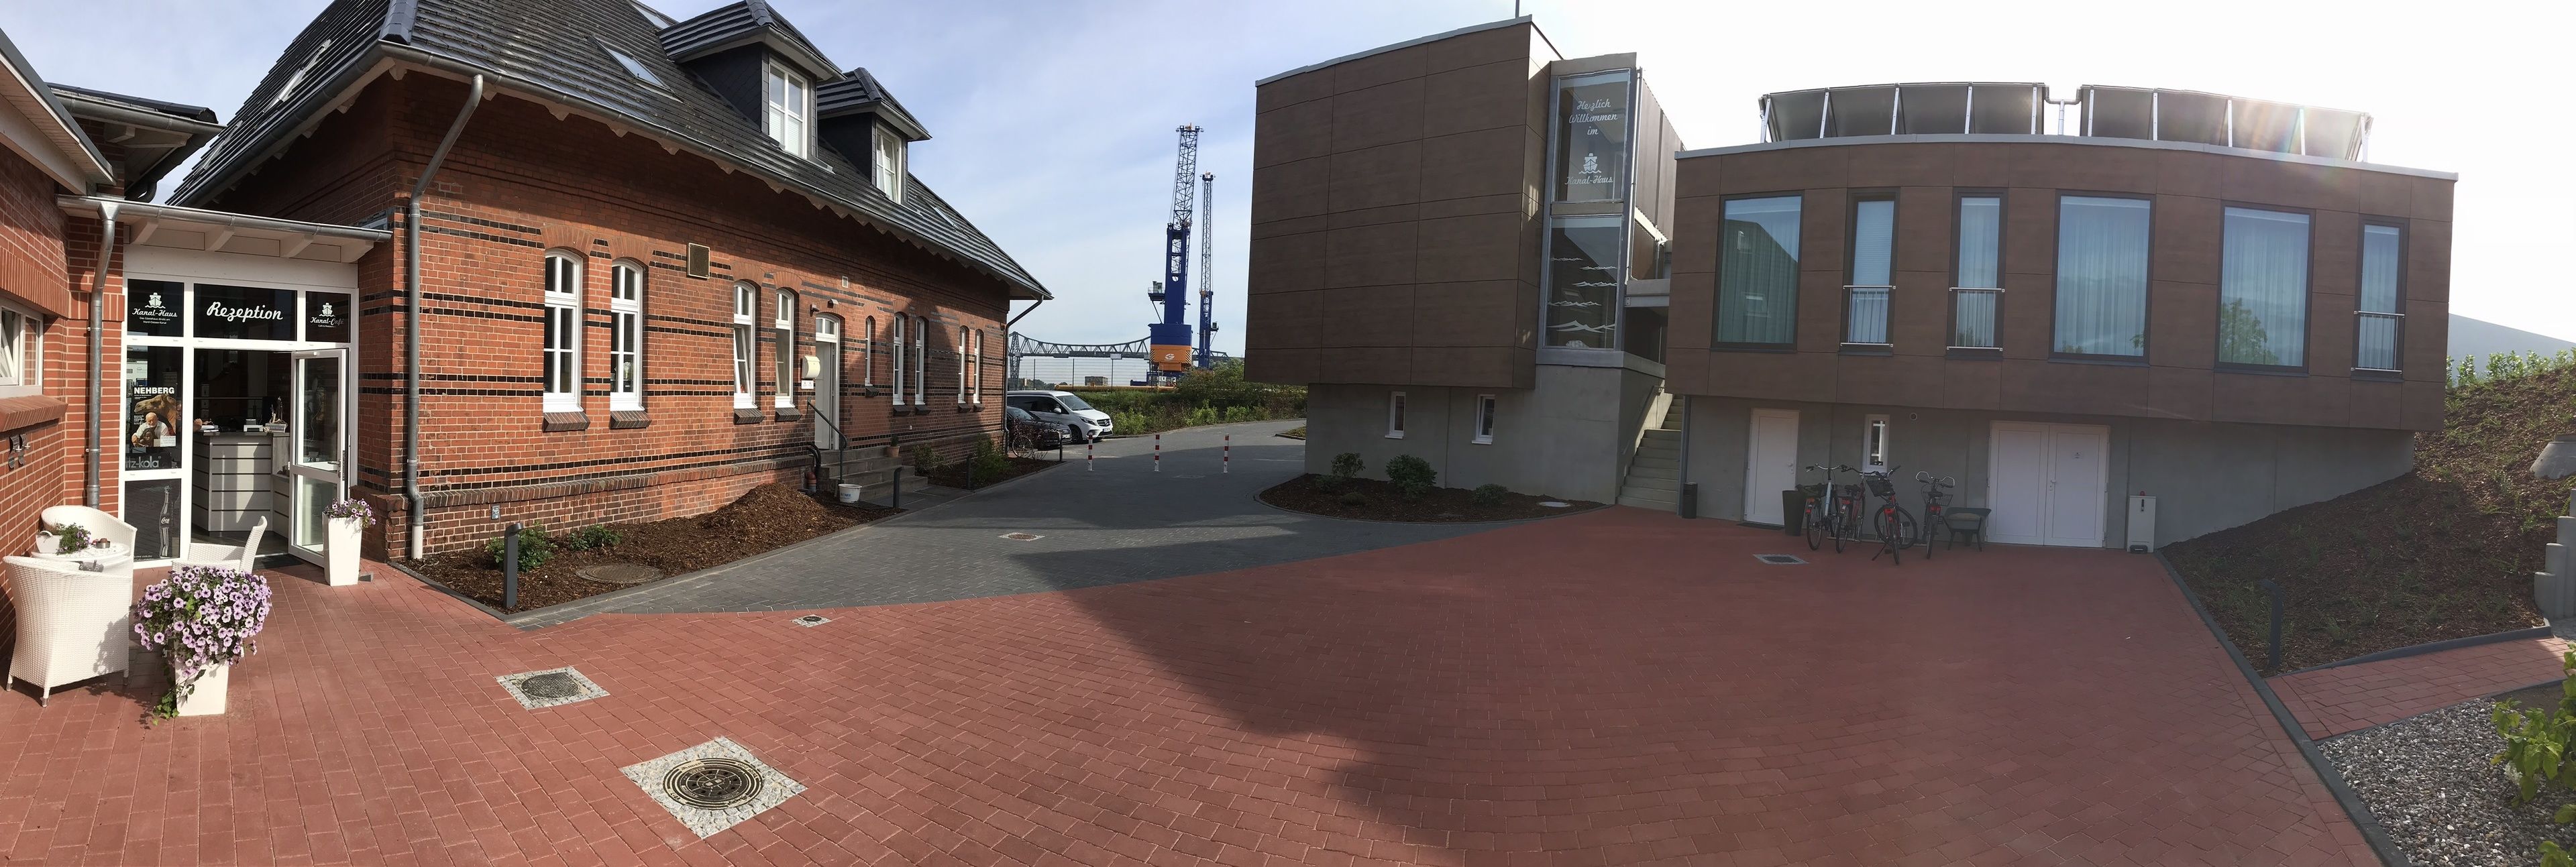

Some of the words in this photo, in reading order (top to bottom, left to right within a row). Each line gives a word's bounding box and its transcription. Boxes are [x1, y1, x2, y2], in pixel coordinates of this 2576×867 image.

[1576, 99, 1611, 111] Herzlich
[1569, 113, 1617, 123] Willkommen
[1587, 126, 1599, 135] im
[1564, 175, 1613, 184] Kanal-Haus
[132, 308, 178, 317] Kanal-Haus
[207, 301, 283, 323] Rezeption
[310, 316, 344, 325] Kanal-Café
